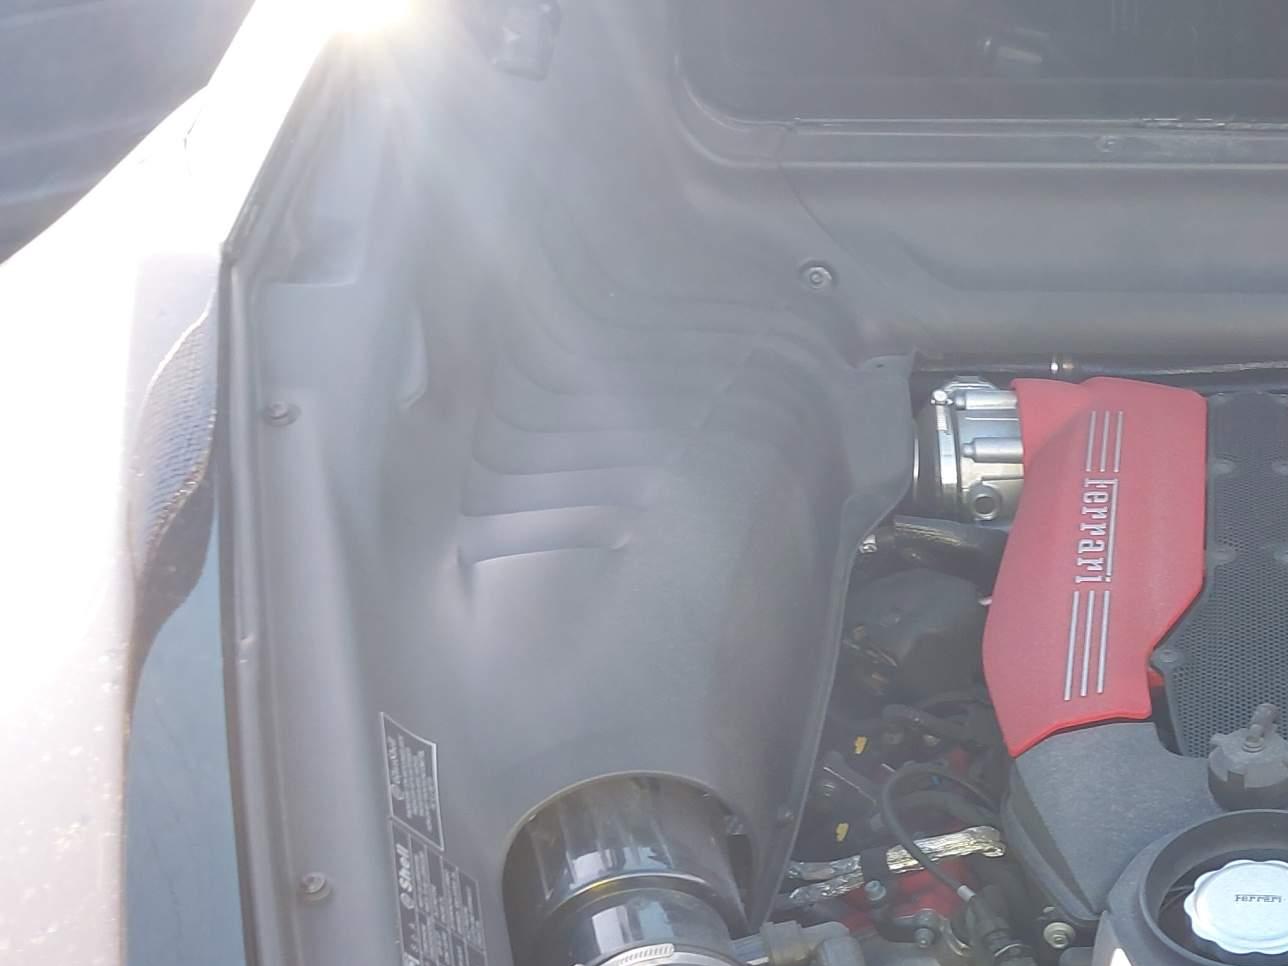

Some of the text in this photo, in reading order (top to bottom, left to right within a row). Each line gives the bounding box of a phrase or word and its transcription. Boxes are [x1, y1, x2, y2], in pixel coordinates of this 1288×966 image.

[1074, 478, 1119, 584] Ferrari
[396, 844, 413, 893] Shell
[1234, 893, 1283, 904] Ferrari
